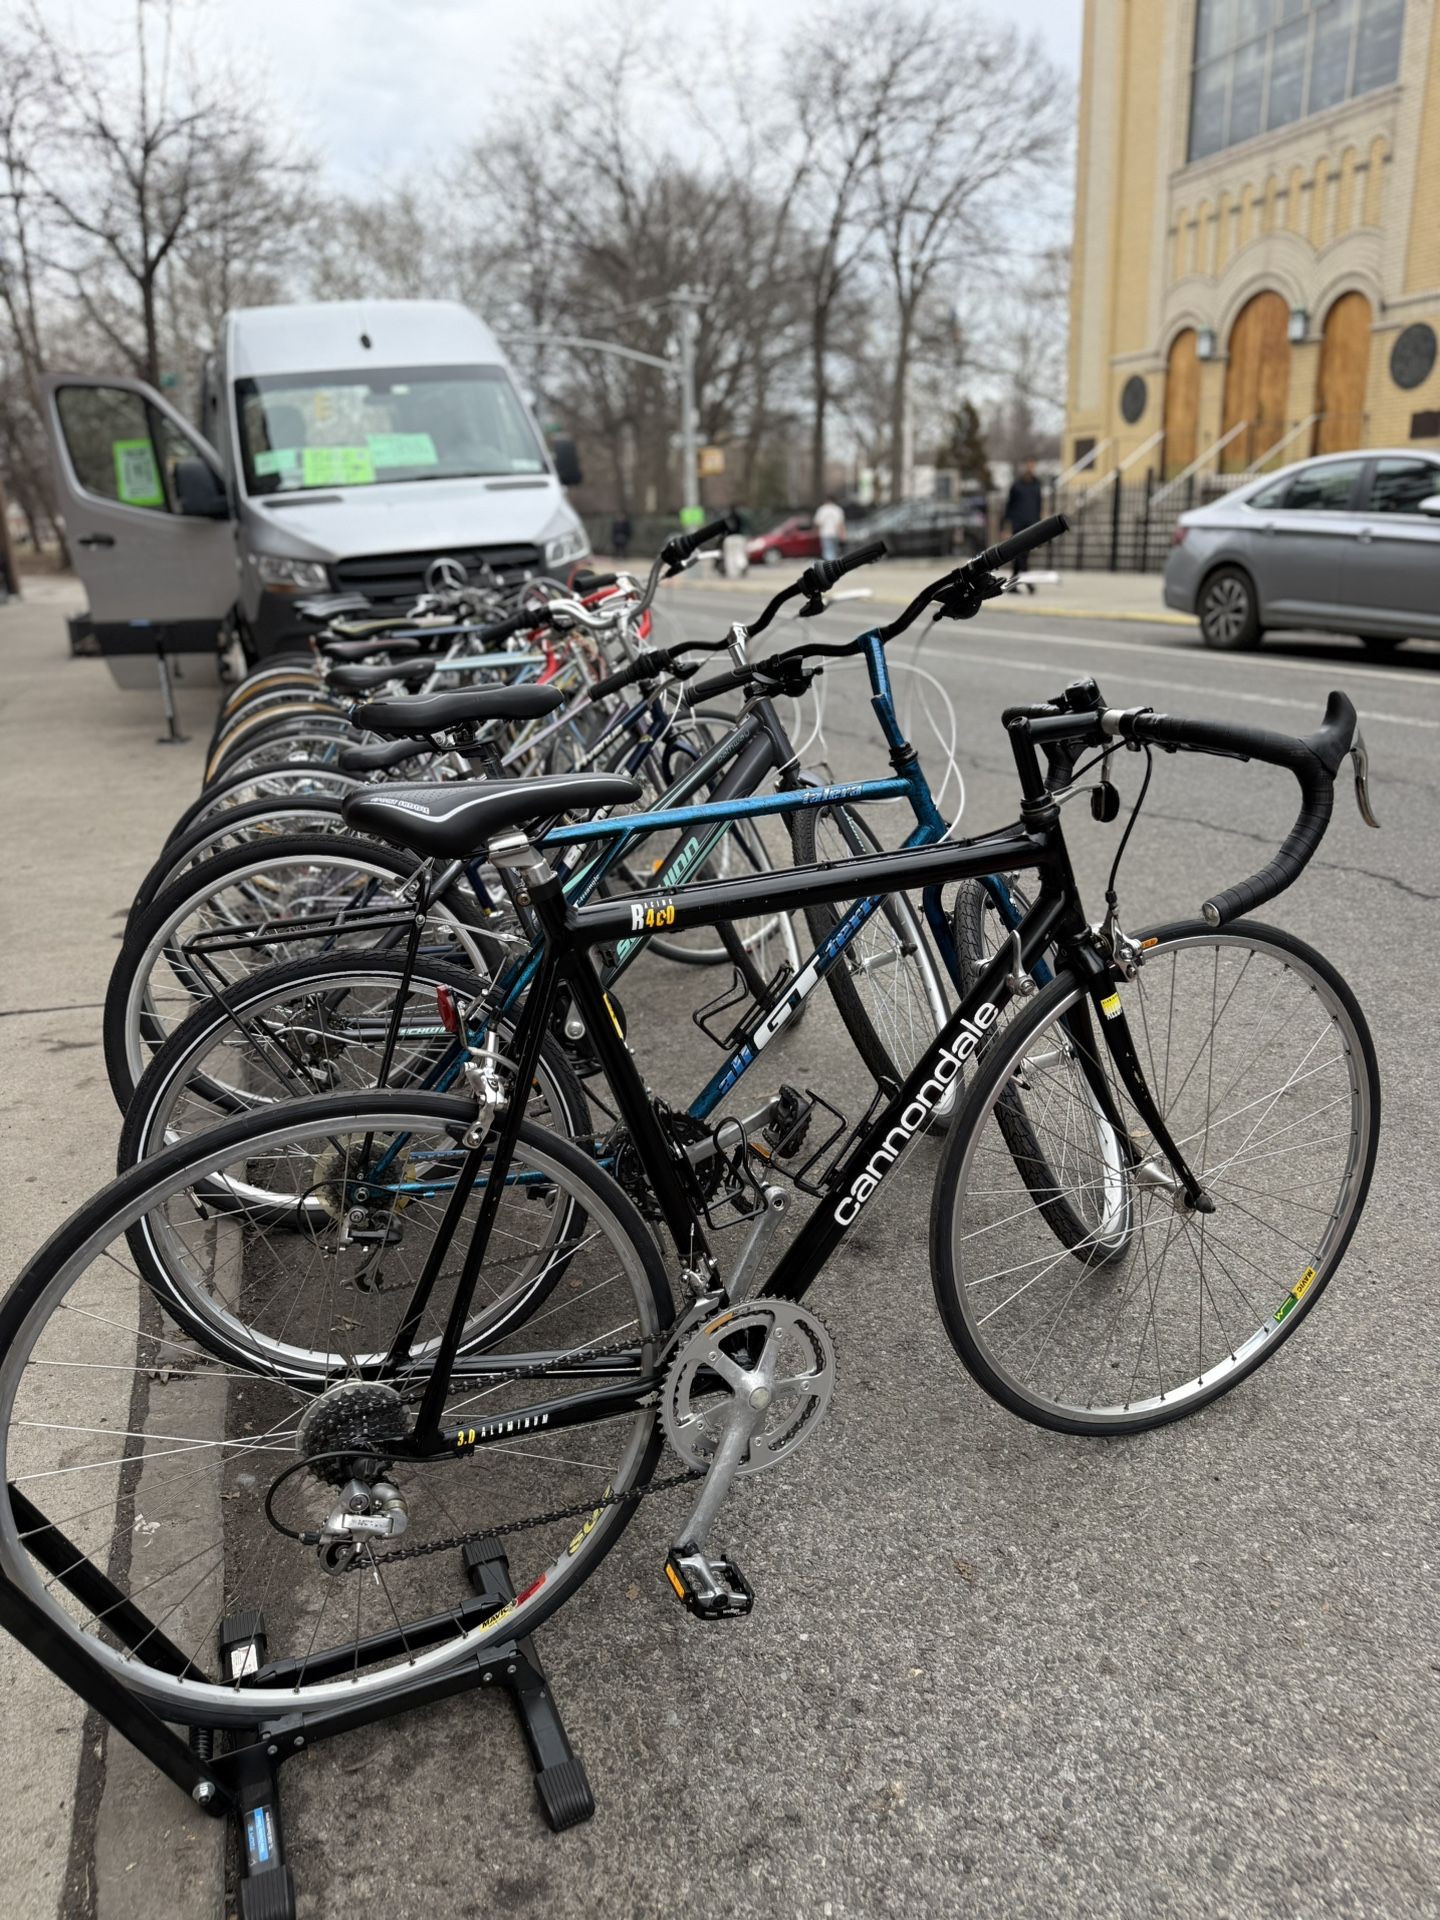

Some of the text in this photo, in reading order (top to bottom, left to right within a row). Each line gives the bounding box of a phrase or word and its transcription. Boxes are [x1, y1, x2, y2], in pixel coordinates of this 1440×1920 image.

[753, 954, 820, 1050] GT
[834, 1002, 999, 1226] cannondale
[1297, 1269, 1313, 1292] MAVIC
[481, 1413, 549, 1438] ALUMINUM
[482, 1607, 509, 1628] MAVIC
